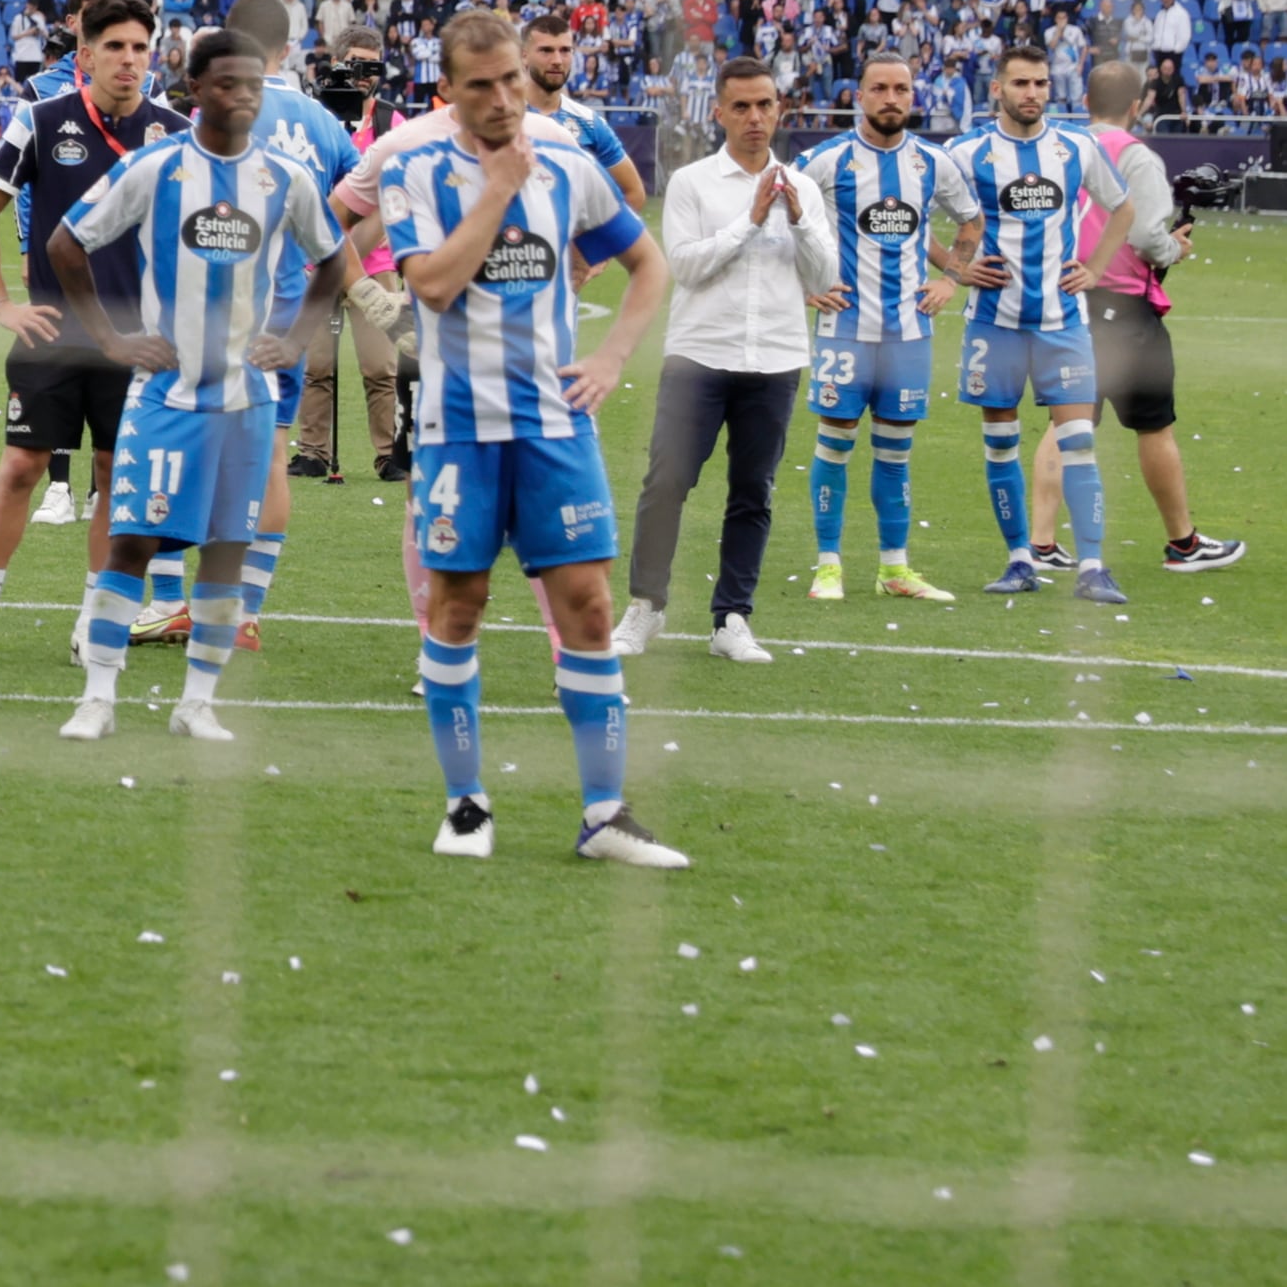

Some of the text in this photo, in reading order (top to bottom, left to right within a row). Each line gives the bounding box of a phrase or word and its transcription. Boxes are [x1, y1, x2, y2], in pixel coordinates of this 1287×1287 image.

[1010, 185, 1055, 198] Estrella
[1011, 196, 1053, 210] Galicia
[868, 209, 912, 221] Estrella
[194, 216, 250, 234] Estrella
[869, 220, 910, 233] Galicia
[196, 231, 247, 249] Galicia
[484, 261, 545, 280] Galicia
[968, 338, 989, 372] 2
[817, 348, 856, 385] 23
[148, 448, 183, 494] 11
[429, 464, 461, 515] 4
